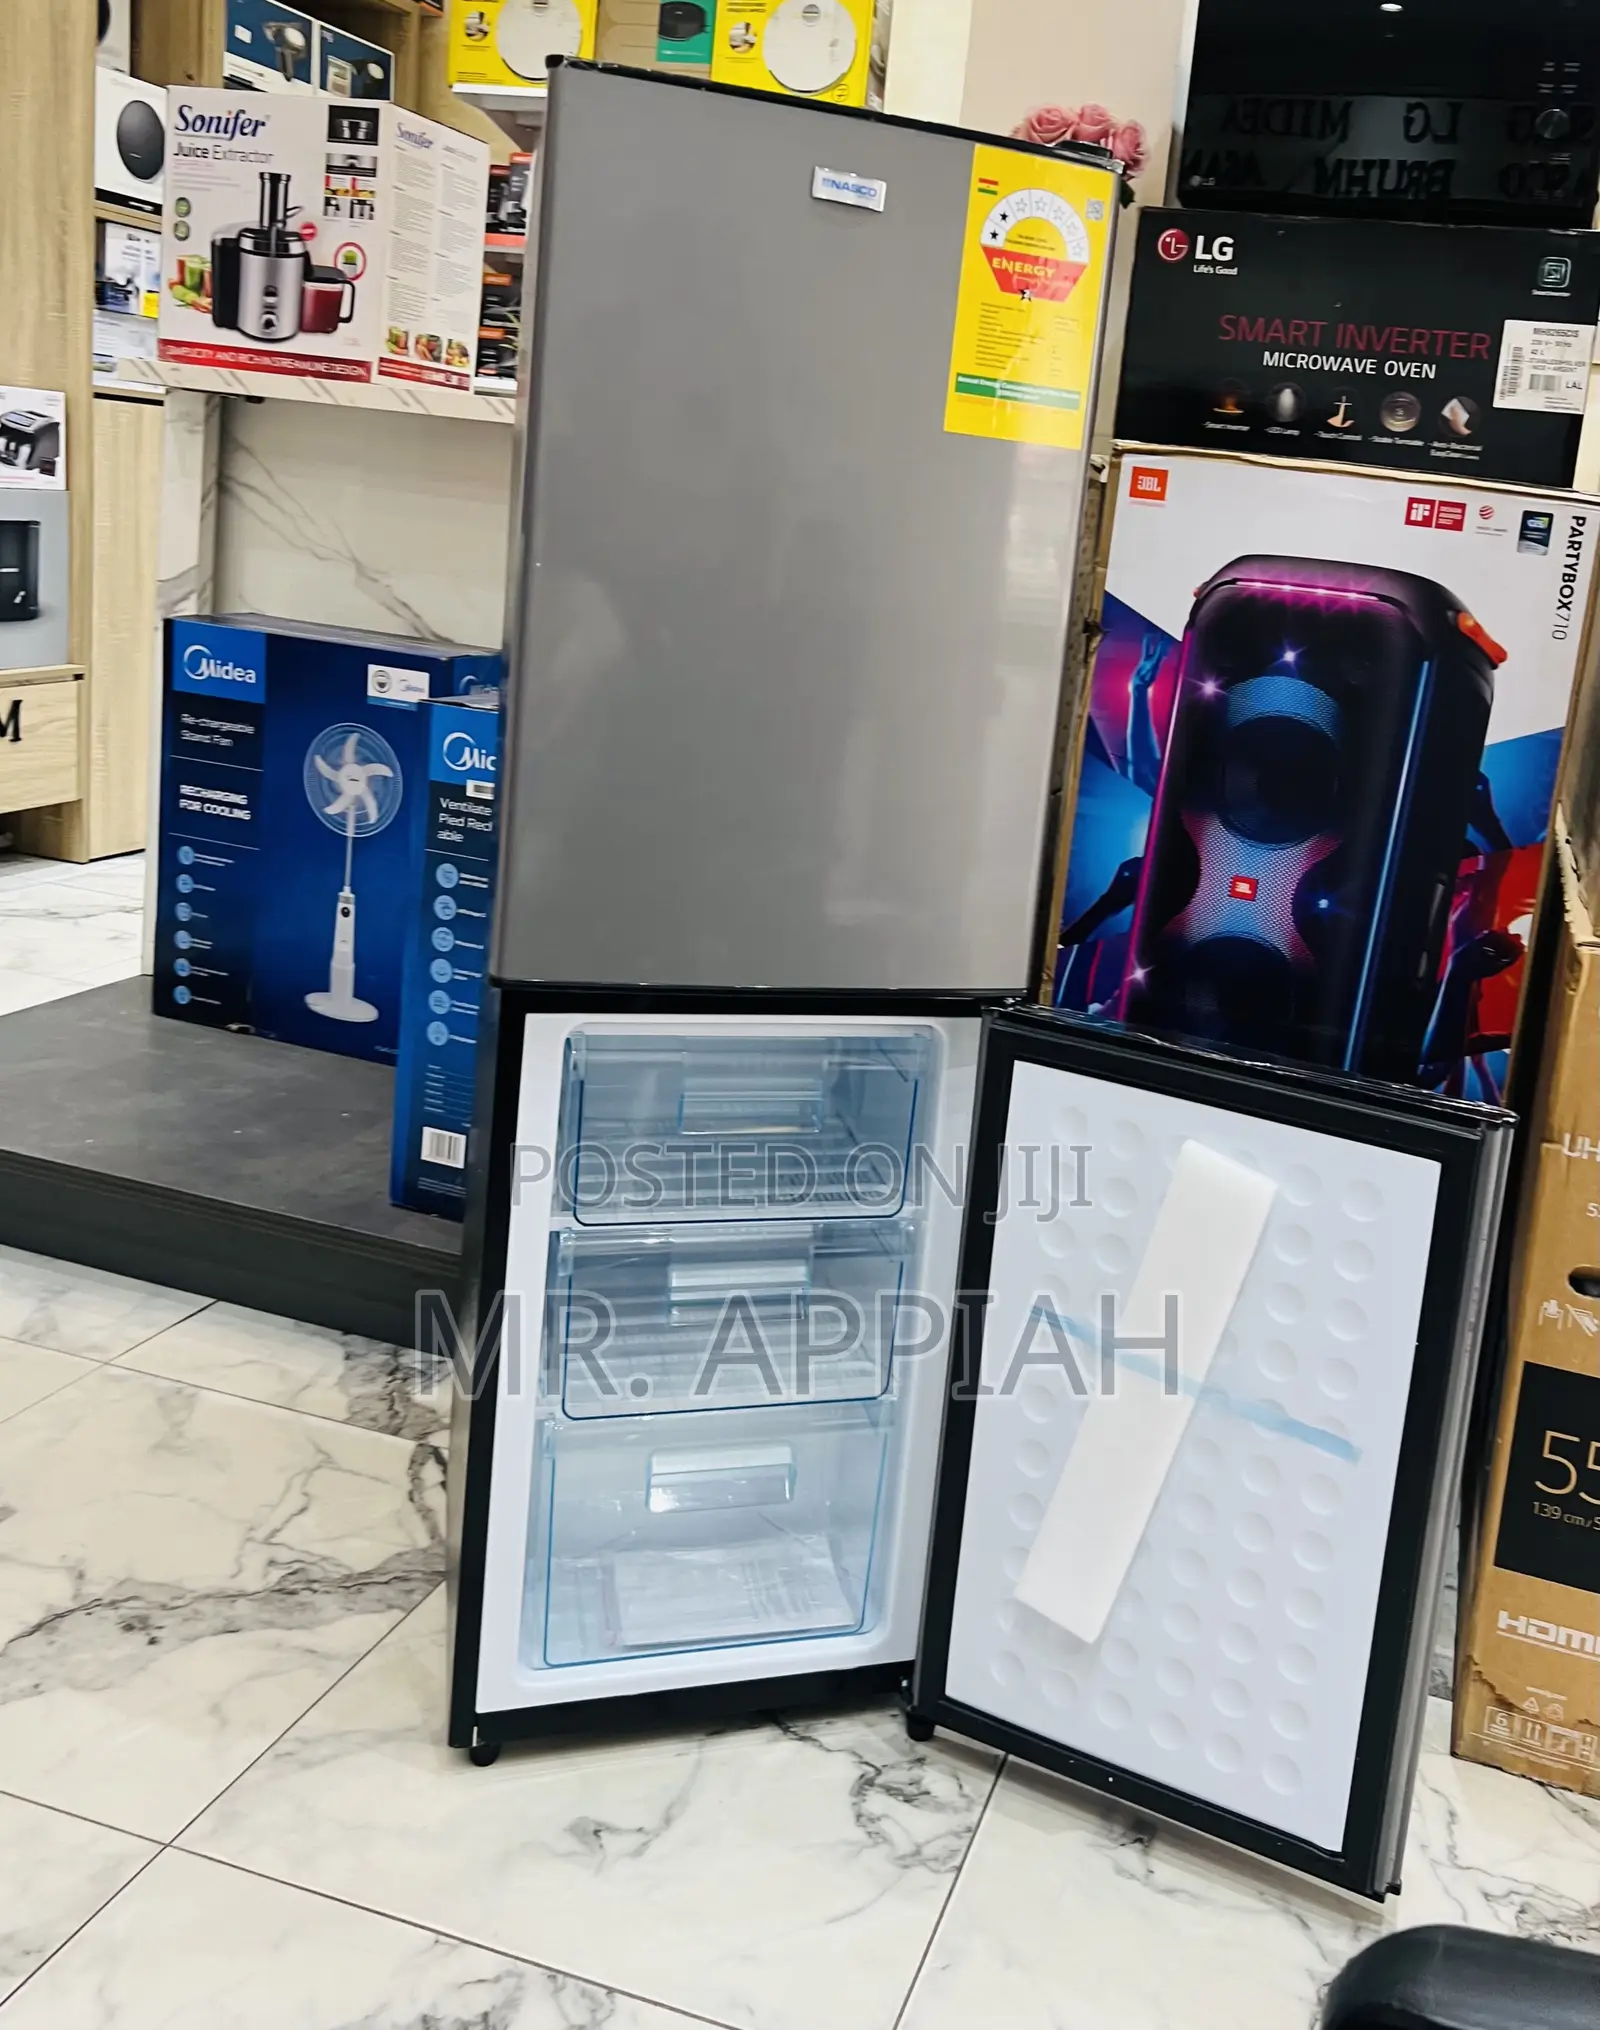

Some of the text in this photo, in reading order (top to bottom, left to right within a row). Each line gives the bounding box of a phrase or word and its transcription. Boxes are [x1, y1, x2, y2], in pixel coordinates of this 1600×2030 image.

[174, 104, 266, 141] Sonifer
[173, 142, 274, 164] Juice Extractor
[1194, 234, 1235, 262] LG
[992, 257, 1056, 278] ENERGY
[1218, 314, 1492, 361] SMART INVERTER
[1262, 351, 1437, 380] MICROWAVE OVEN
[1566, 381, 1583, 390] LAL
[1137, 475, 1162, 493] JBL
[185, 647, 256, 684] Midea
[179, 784, 248, 805] RECHARGING
[179, 798, 252, 820] FOR COOLING
[439, 797, 493, 817] Ventilate
[436, 829, 465, 843] able
[1533, 1501, 1562, 1520] 139
